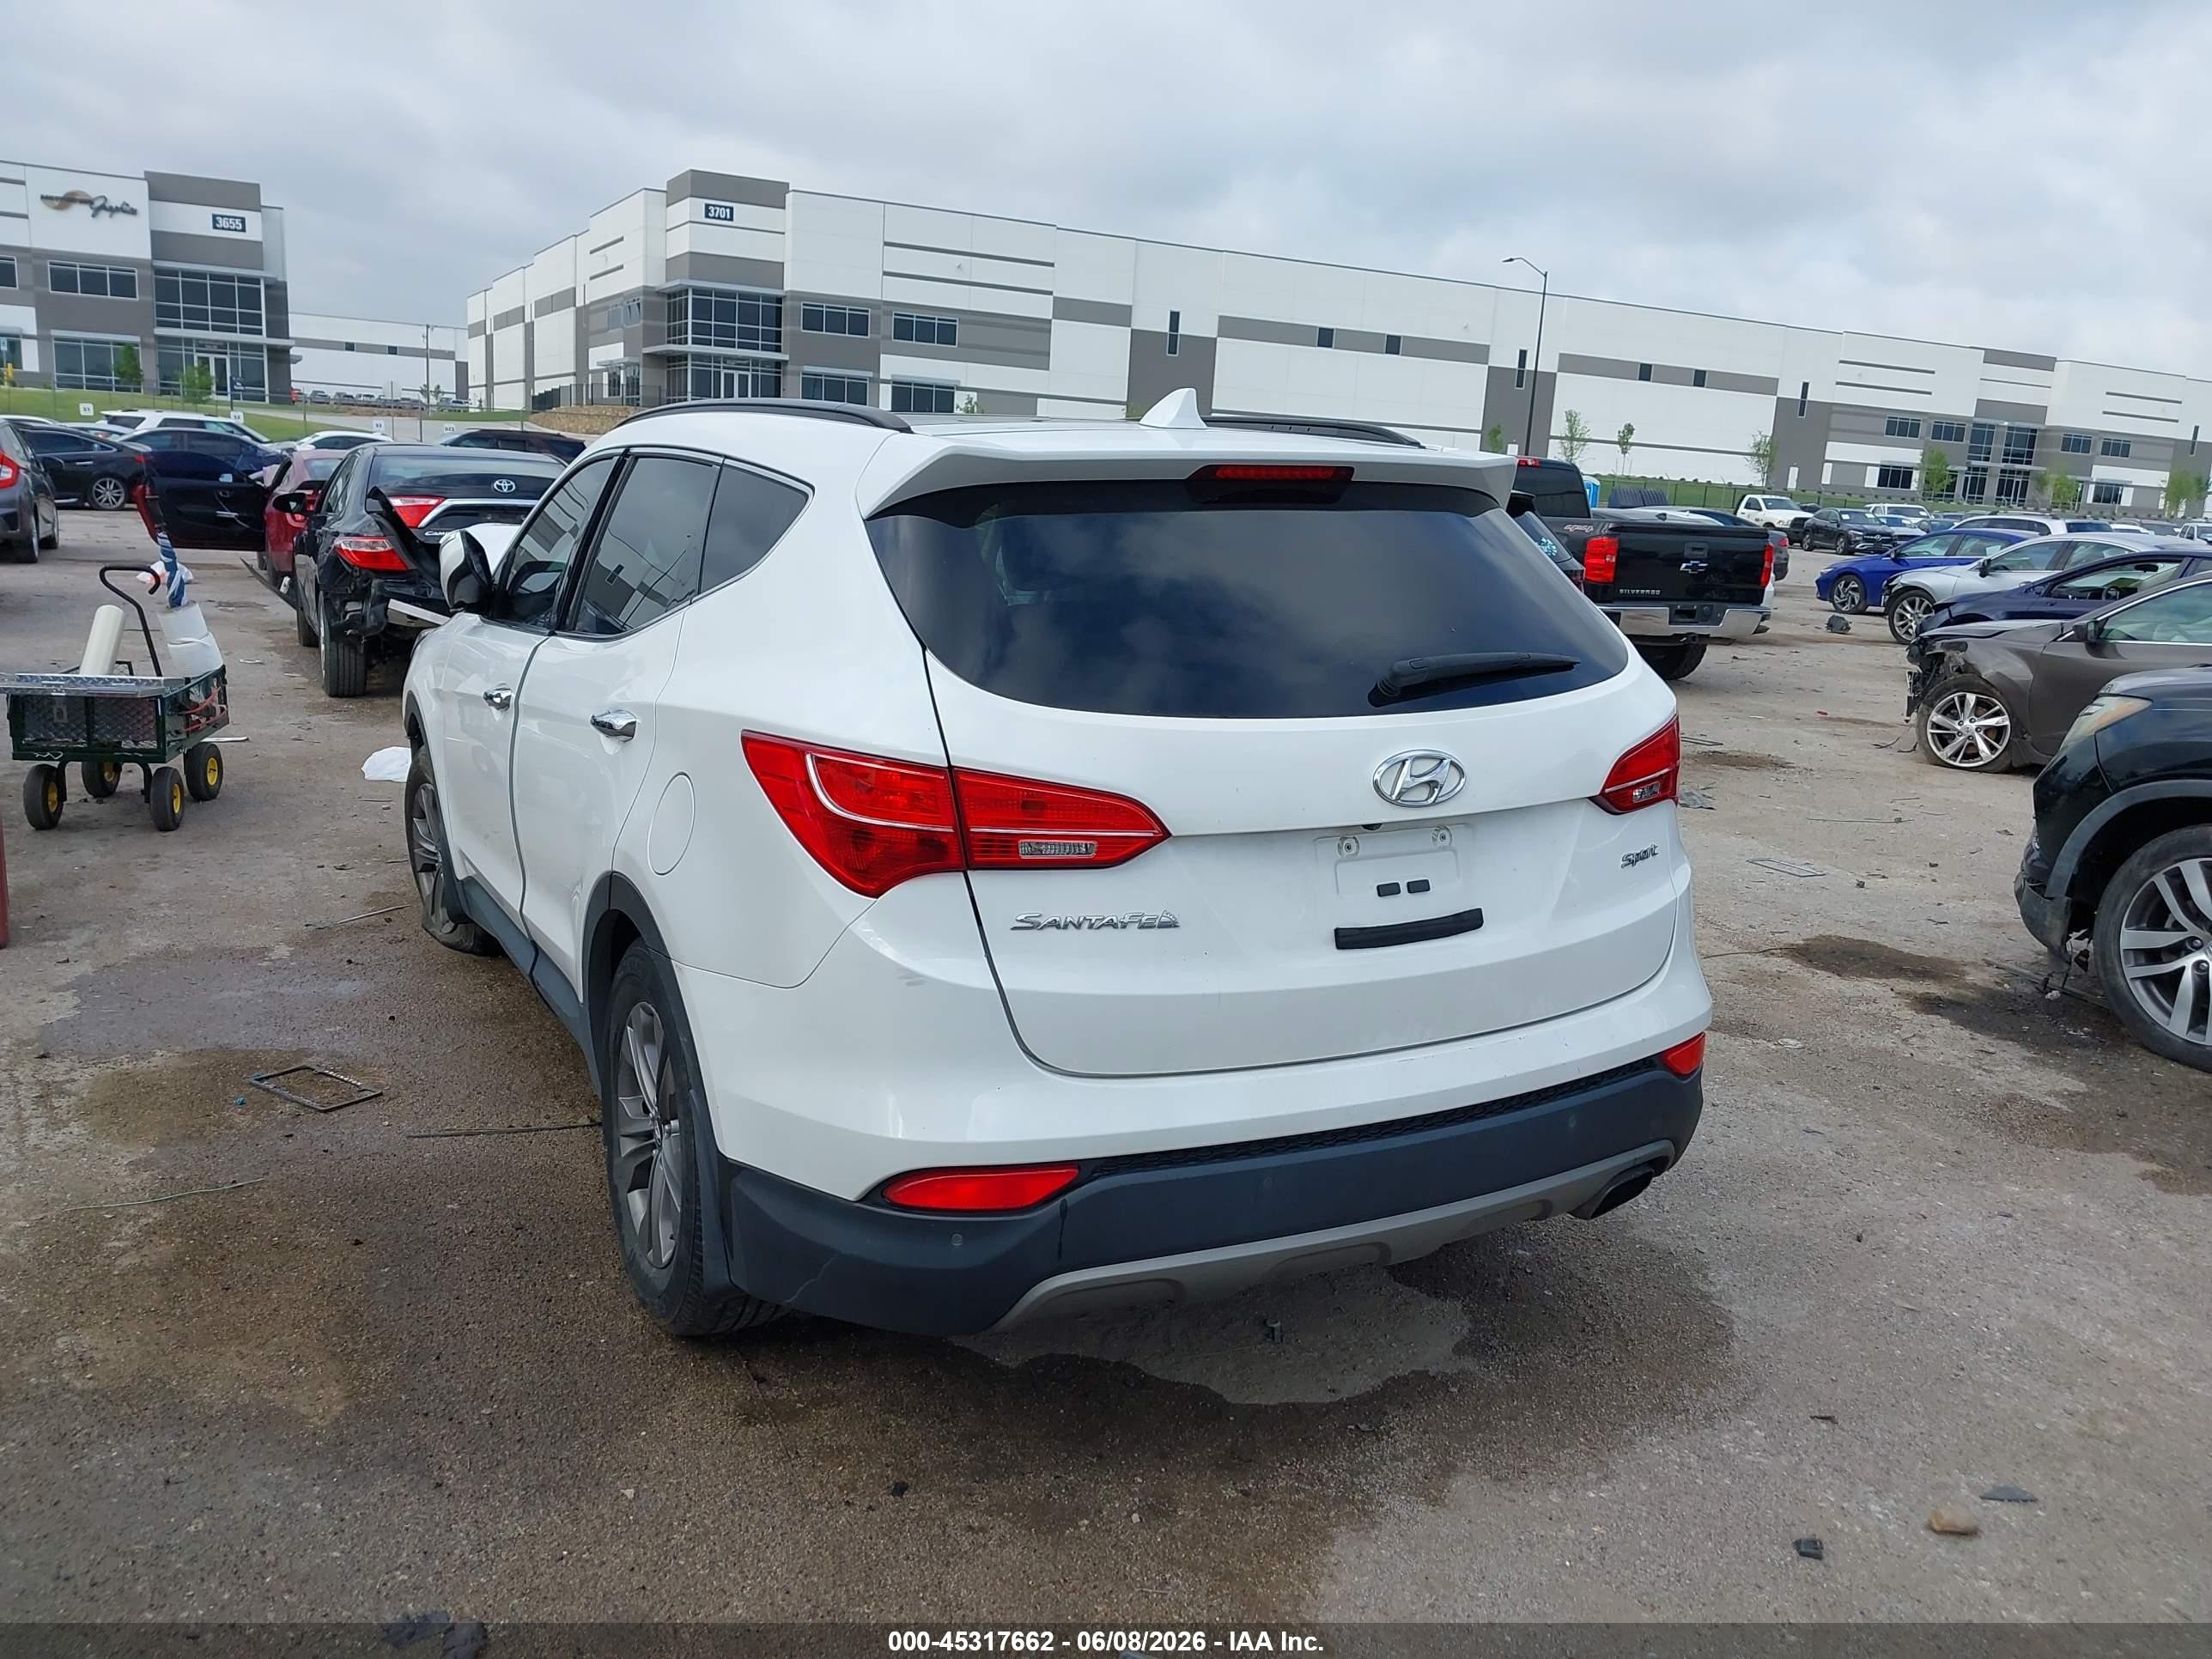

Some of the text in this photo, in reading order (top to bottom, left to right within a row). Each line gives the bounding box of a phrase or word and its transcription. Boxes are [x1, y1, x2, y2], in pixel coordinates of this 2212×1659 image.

[708, 206, 731, 220] 3701
[215, 216, 243, 230] 3655
[1620, 843, 1659, 868] Sport
